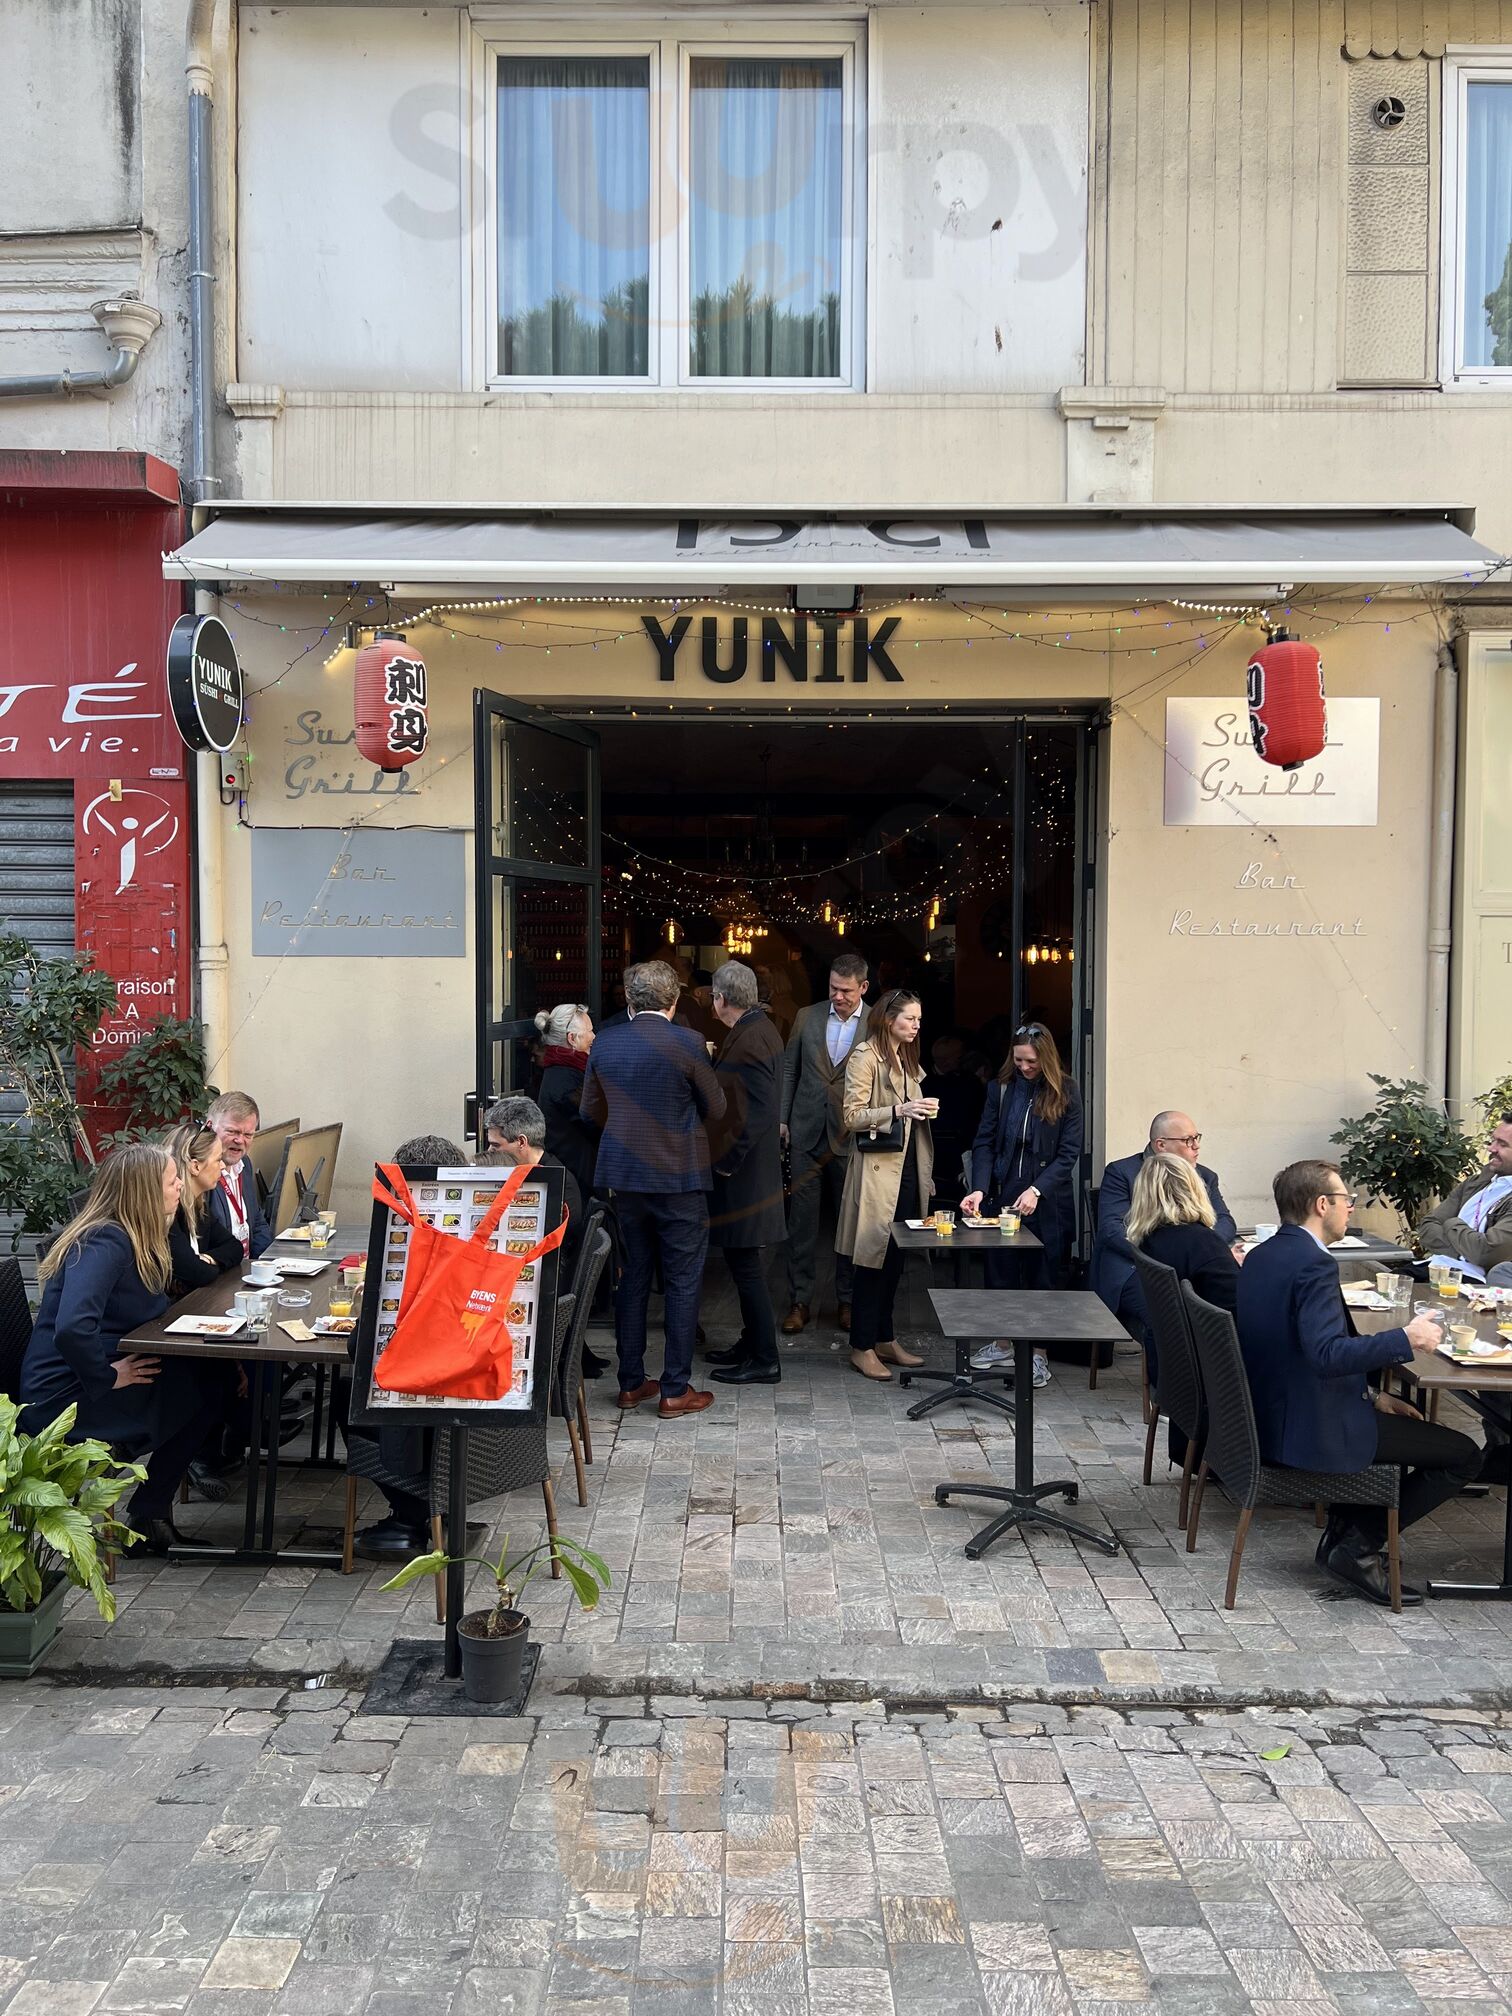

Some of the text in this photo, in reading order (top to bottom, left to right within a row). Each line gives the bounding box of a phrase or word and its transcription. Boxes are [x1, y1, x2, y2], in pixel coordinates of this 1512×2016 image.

[641, 616, 905, 684] YUNIK
[199, 654, 233, 693] YUNIK
[199, 682, 218, 700] SUSHI
[384, 656, 429, 754] 刺身
[48, 731, 140, 753] vie.
[285, 755, 422, 799] Grill
[1200, 757, 1336, 801] Grill
[327, 854, 397, 880] Bar
[1234, 861, 1306, 889] Bar
[260, 900, 459, 929] Restaurant
[1169, 908, 1368, 937] Restaurant
[117, 979, 174, 995] raison
[125, 1002, 140, 1020] A
[470, 1289, 497, 1303] BYENS
